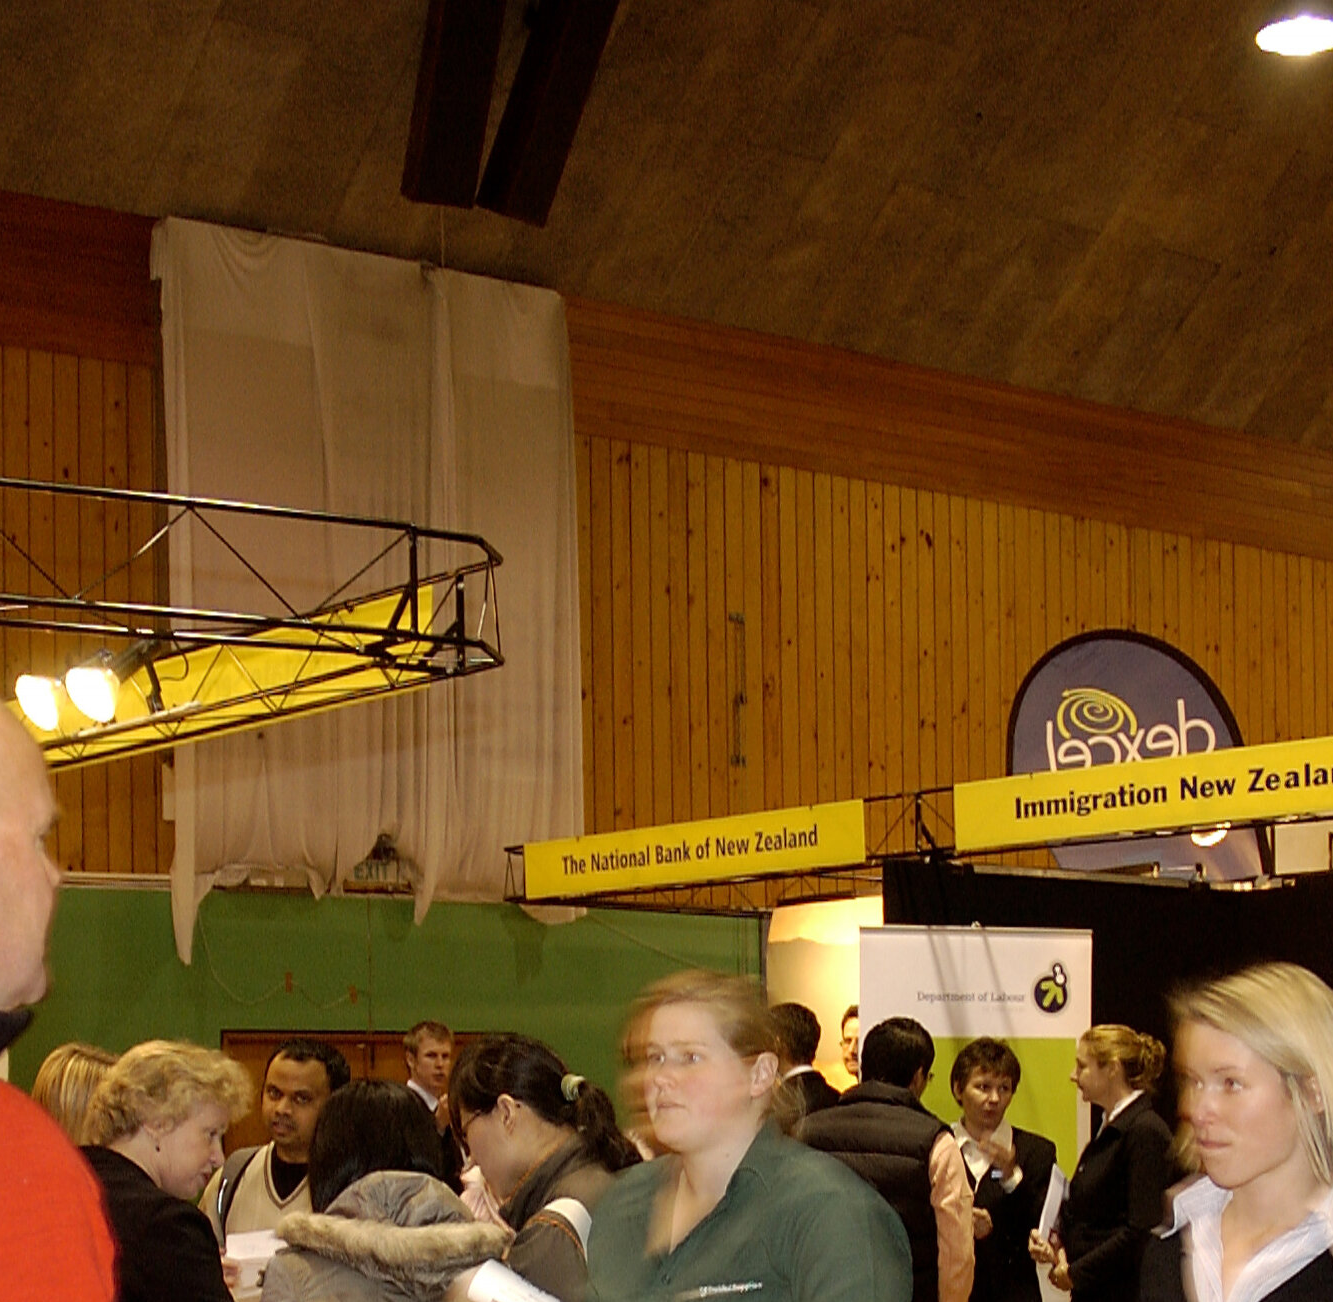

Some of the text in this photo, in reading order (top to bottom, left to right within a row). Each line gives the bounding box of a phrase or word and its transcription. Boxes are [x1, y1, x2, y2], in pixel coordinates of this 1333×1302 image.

[1015, 783, 1168, 819] Immigration
[1179, 775, 1236, 801] New
[561, 824, 818, 875] The National Bank of New Zealand
[917, 992, 975, 1004] Department
[978, 992, 988, 1001] of
